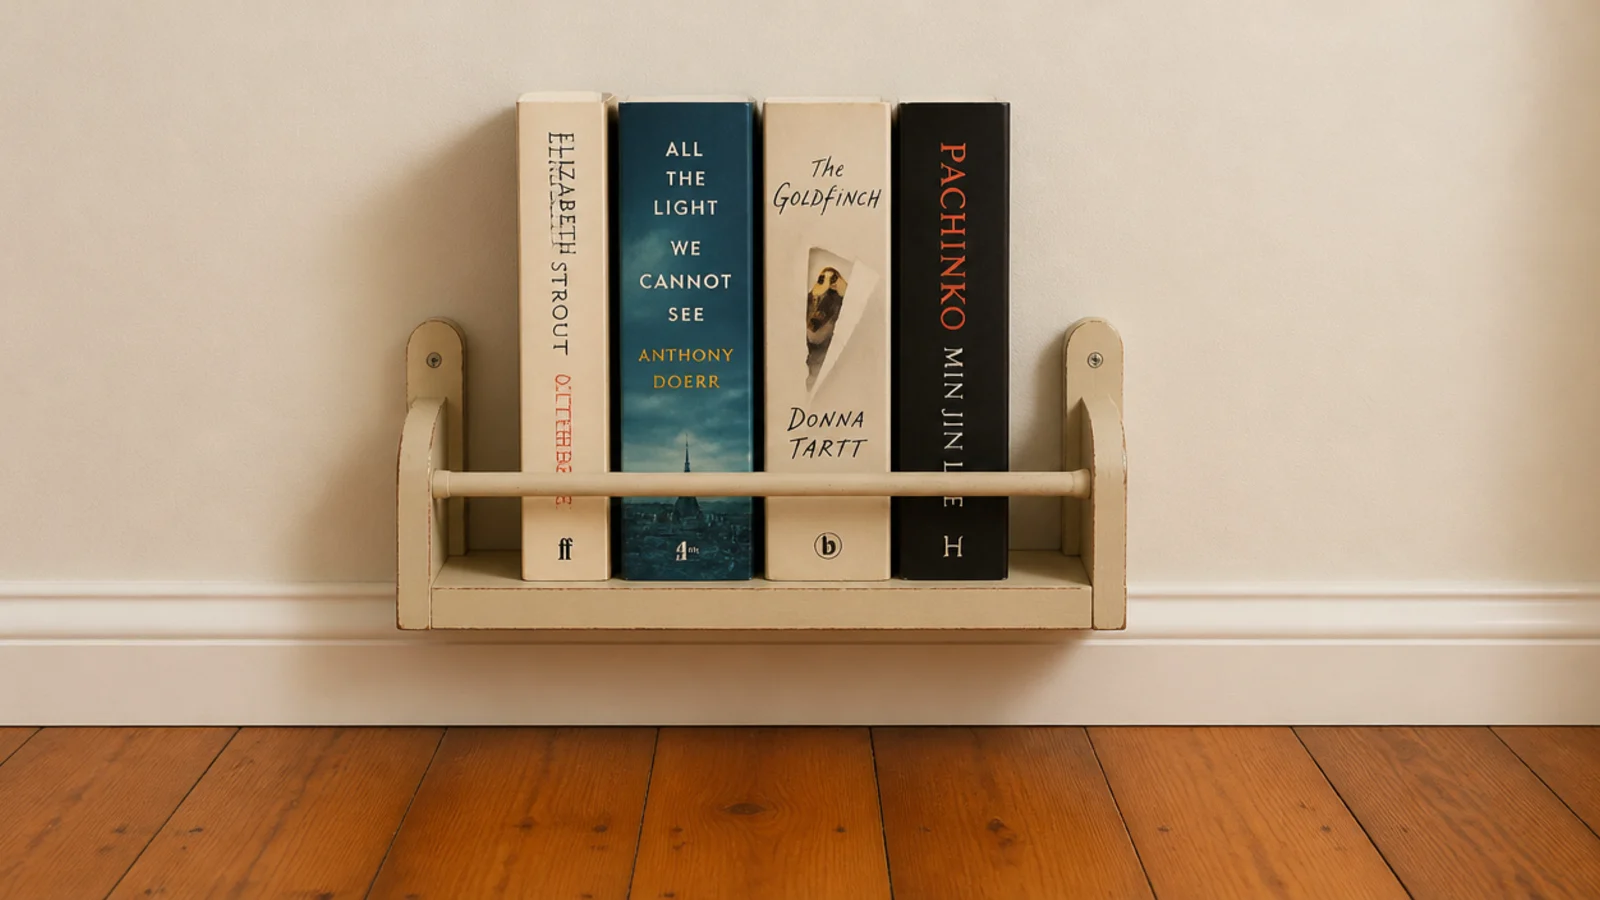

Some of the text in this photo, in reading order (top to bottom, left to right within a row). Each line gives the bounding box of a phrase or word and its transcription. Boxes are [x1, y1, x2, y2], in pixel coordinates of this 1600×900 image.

[665, 141, 704, 157] ALL
[811, 155, 845, 178] The
[666, 171, 706, 186] THE
[558, 132, 576, 254] ELIZABETH
[654, 200, 718, 216] LIGHT
[670, 240, 701, 256] WE
[940, 143, 966, 331] PACHINKO
[639, 273, 732, 290] CANNOT
[551, 261, 568, 356] STROUT
[668, 307, 705, 323] SEE
[638, 348, 734, 363] ANTHONY
[653, 375, 720, 390] DOERR
[787, 406, 864, 432] DONNA
[941, 347, 964, 507] MIN JIN LE
[789, 436, 869, 460] TARTT
[558, 537, 574, 561] ff
[943, 535, 964, 558] H
